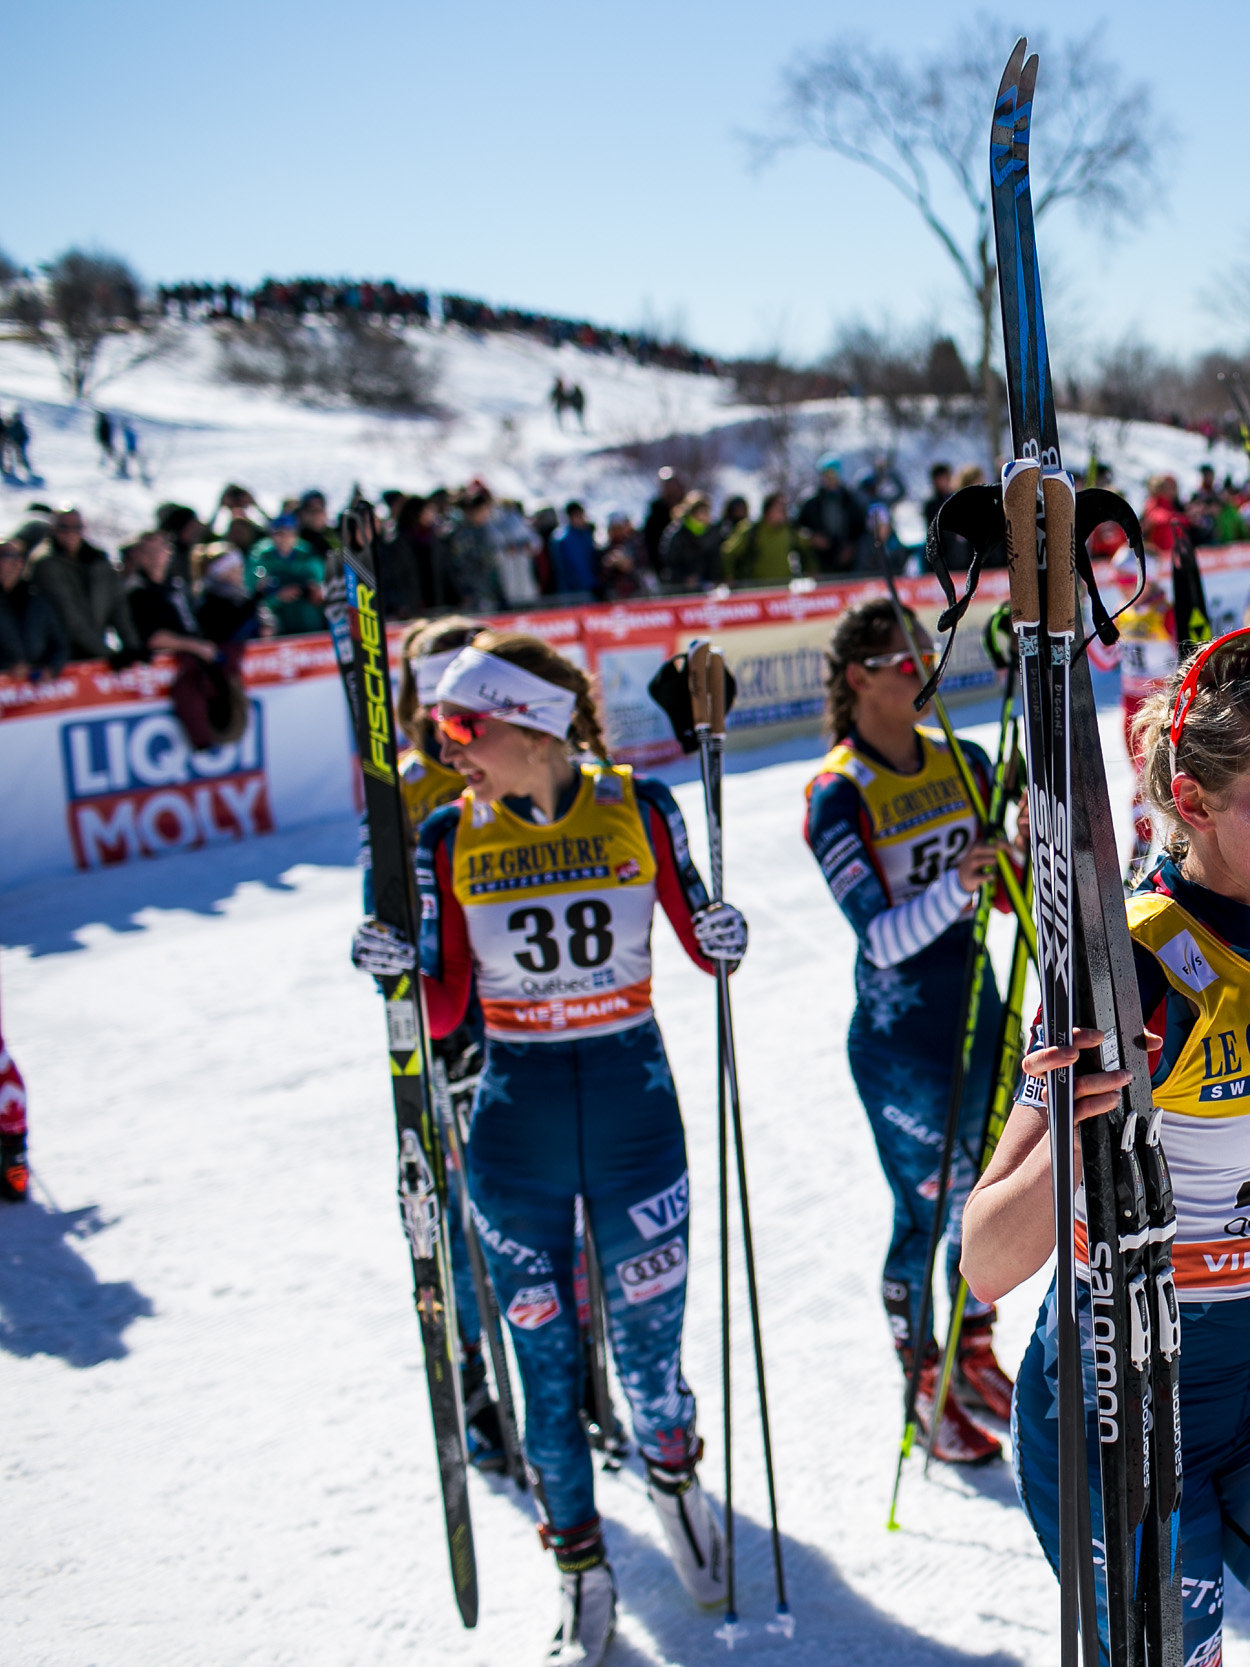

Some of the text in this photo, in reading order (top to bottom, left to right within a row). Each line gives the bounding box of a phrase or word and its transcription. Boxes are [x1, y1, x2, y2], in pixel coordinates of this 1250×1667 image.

[356, 583, 392, 774] FISCHER
[77, 780, 263, 867] MOLY
[468, 852, 494, 880] LE
[507, 899, 615, 974] 38
[521, 977, 591, 997] Québec
[1202, 1029, 1242, 1081] LE
[636, 1182, 689, 1228] VIS
[1091, 1241, 1119, 1444] salomon
[1172, 1384, 1183, 1477] salomon
